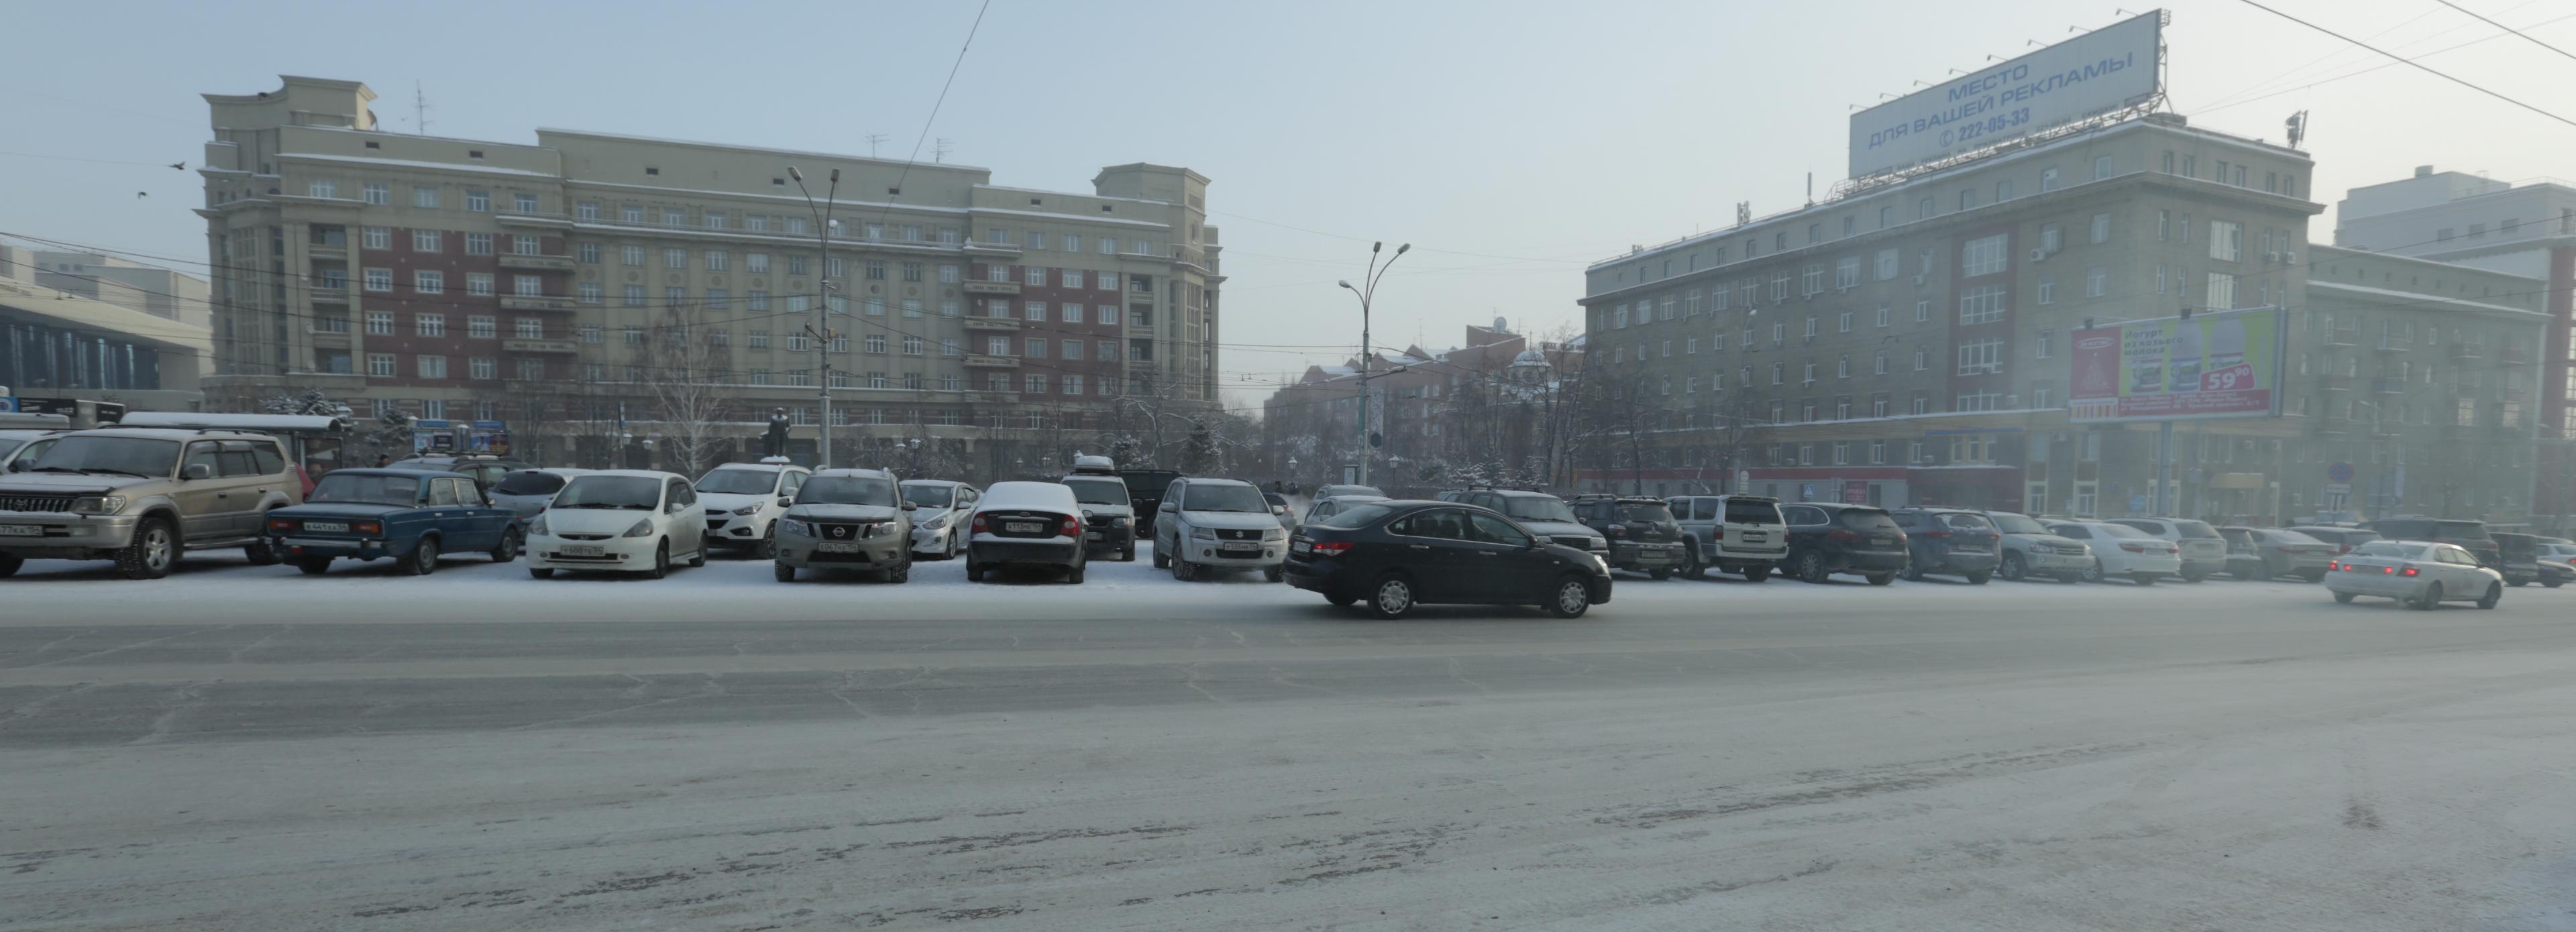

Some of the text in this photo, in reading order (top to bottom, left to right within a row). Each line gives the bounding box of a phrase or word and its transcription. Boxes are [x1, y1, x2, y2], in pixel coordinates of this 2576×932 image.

[1948, 64, 2029, 103] МЕСТО
[1868, 52, 2133, 150] ДЛЯ ВАШЕЙ РЕКЛАМЫ
[1958, 107, 2029, 143] 222-05-33
[2125, 329, 2163, 340] Йогурт
[2139, 337, 2184, 347] козьего
[2124, 347, 2165, 356] молока
[2208, 372, 2237, 390] 59
